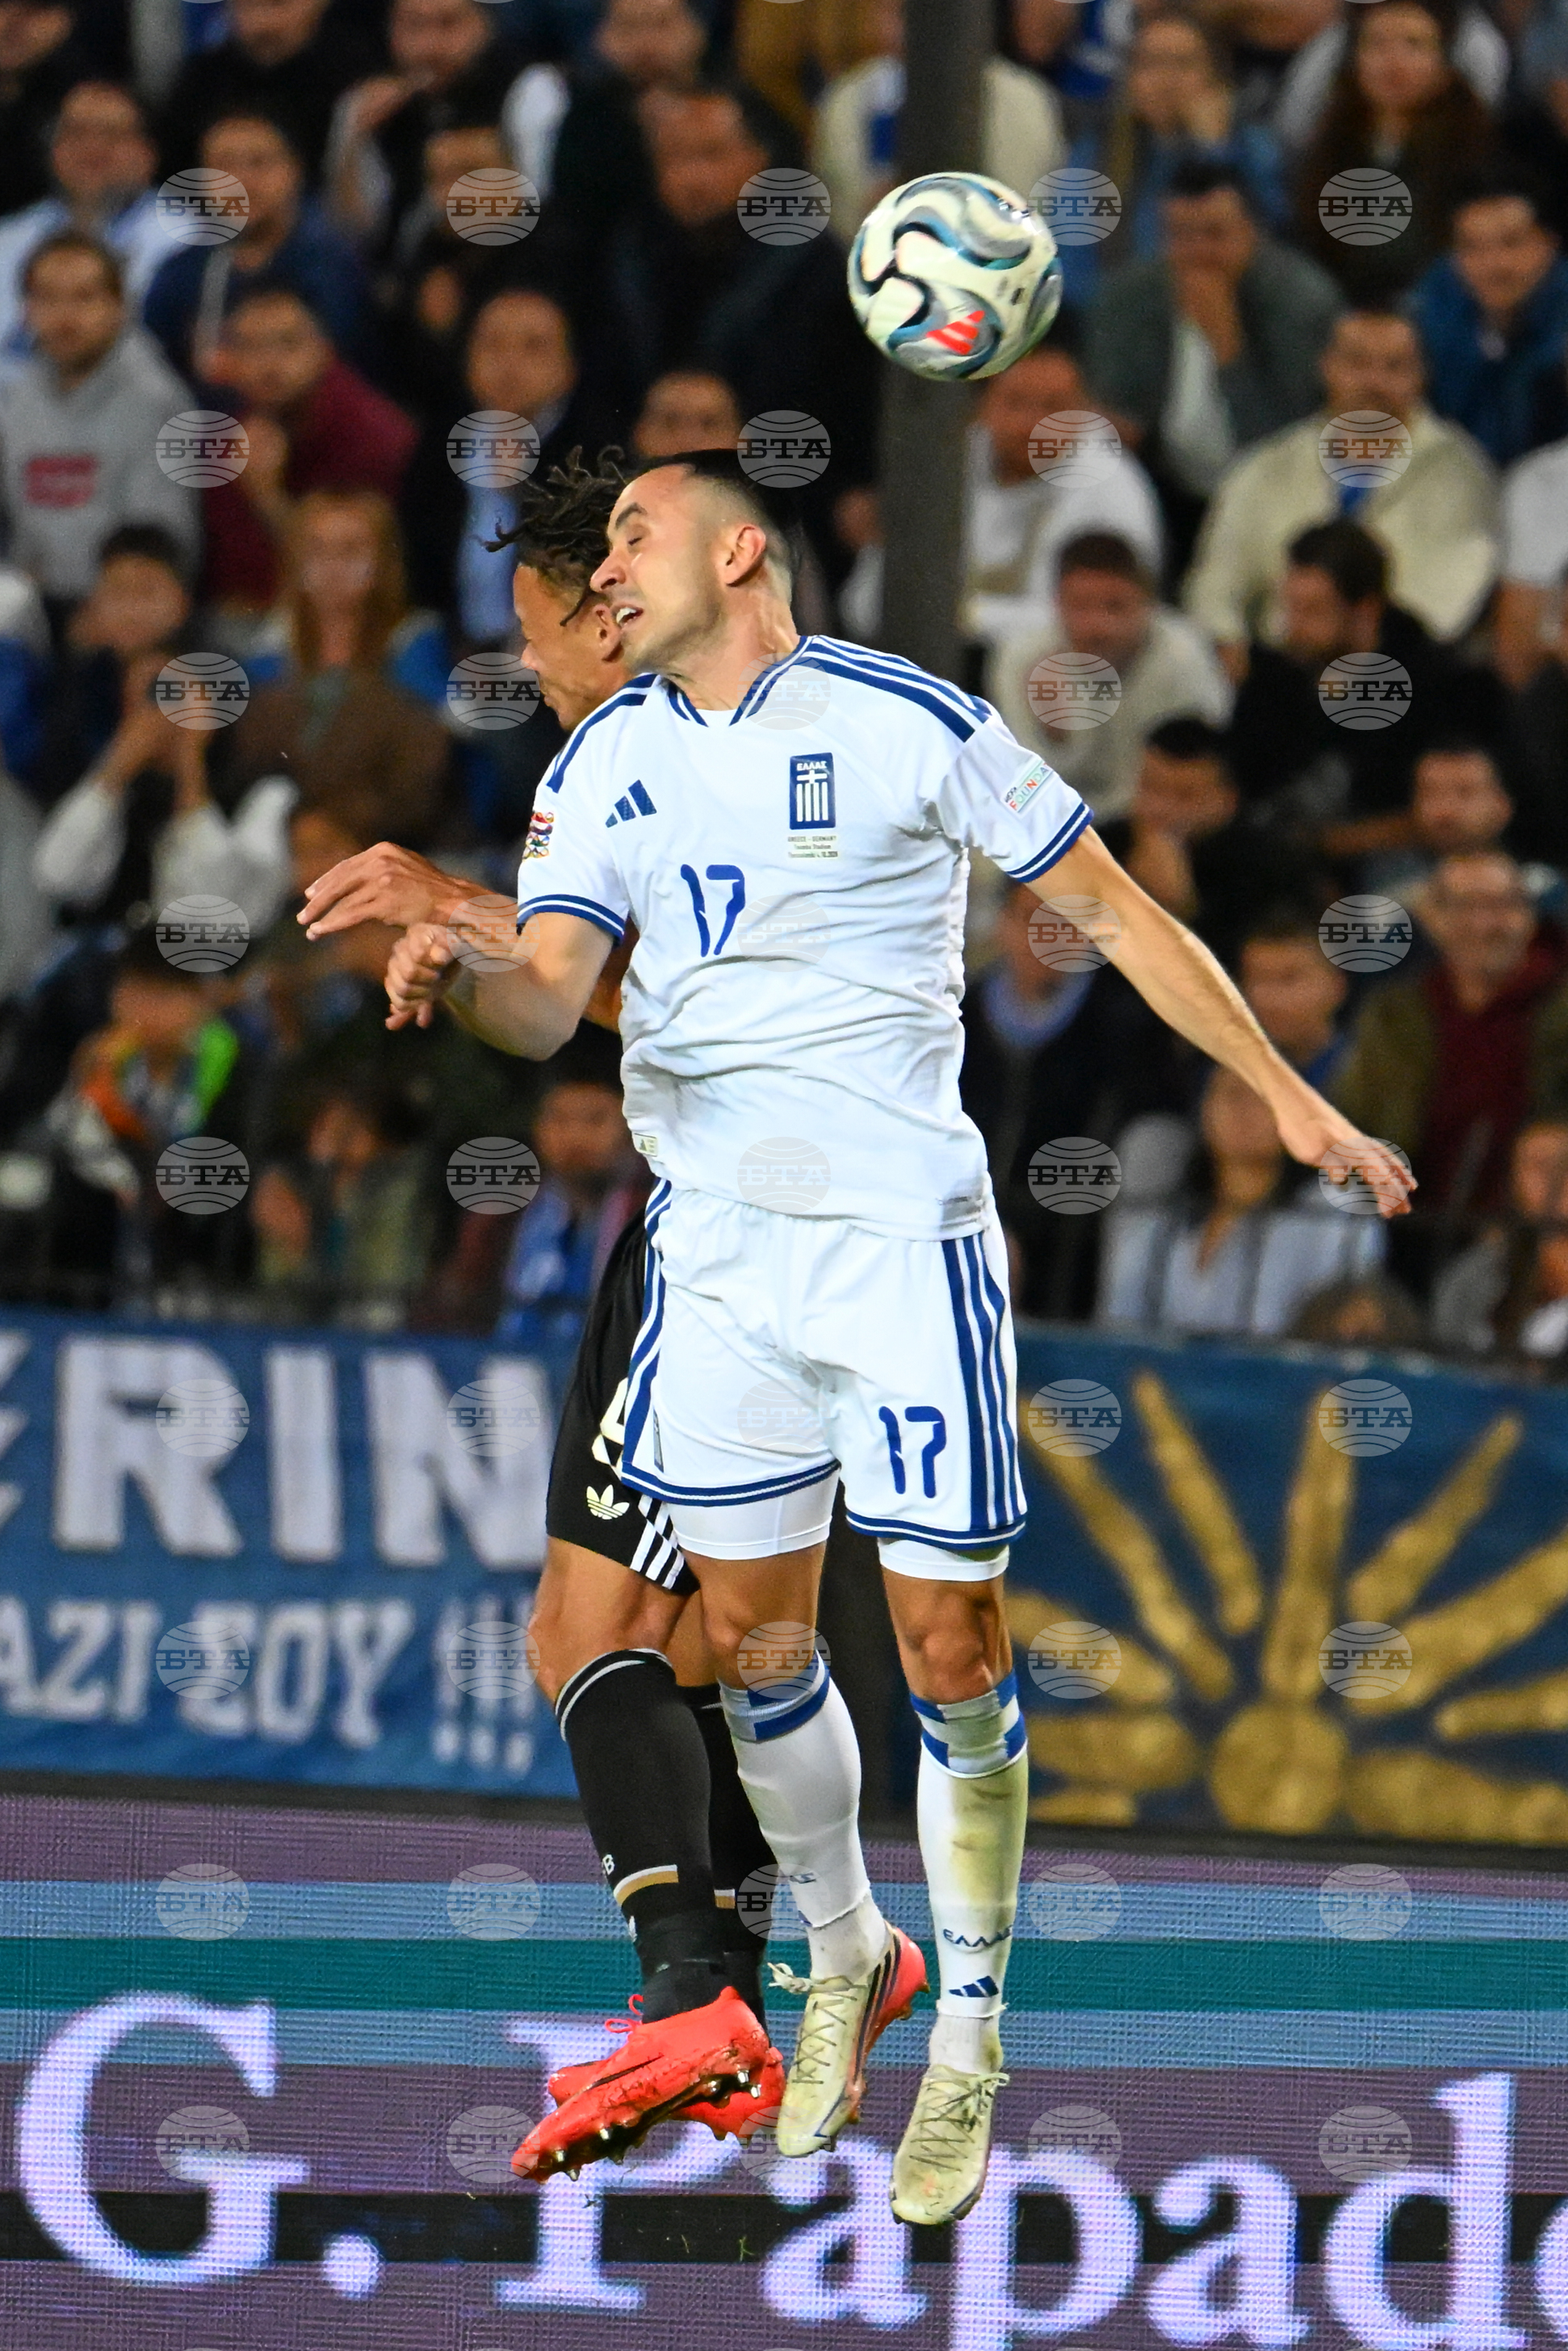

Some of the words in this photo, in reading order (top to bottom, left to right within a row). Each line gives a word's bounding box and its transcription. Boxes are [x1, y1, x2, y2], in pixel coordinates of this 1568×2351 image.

[681, 864, 745, 958] 17
[0, 1327, 551, 1569] RIN
[878, 1406, 946, 1498] 17
[16, 1990, 384, 2301] G.
